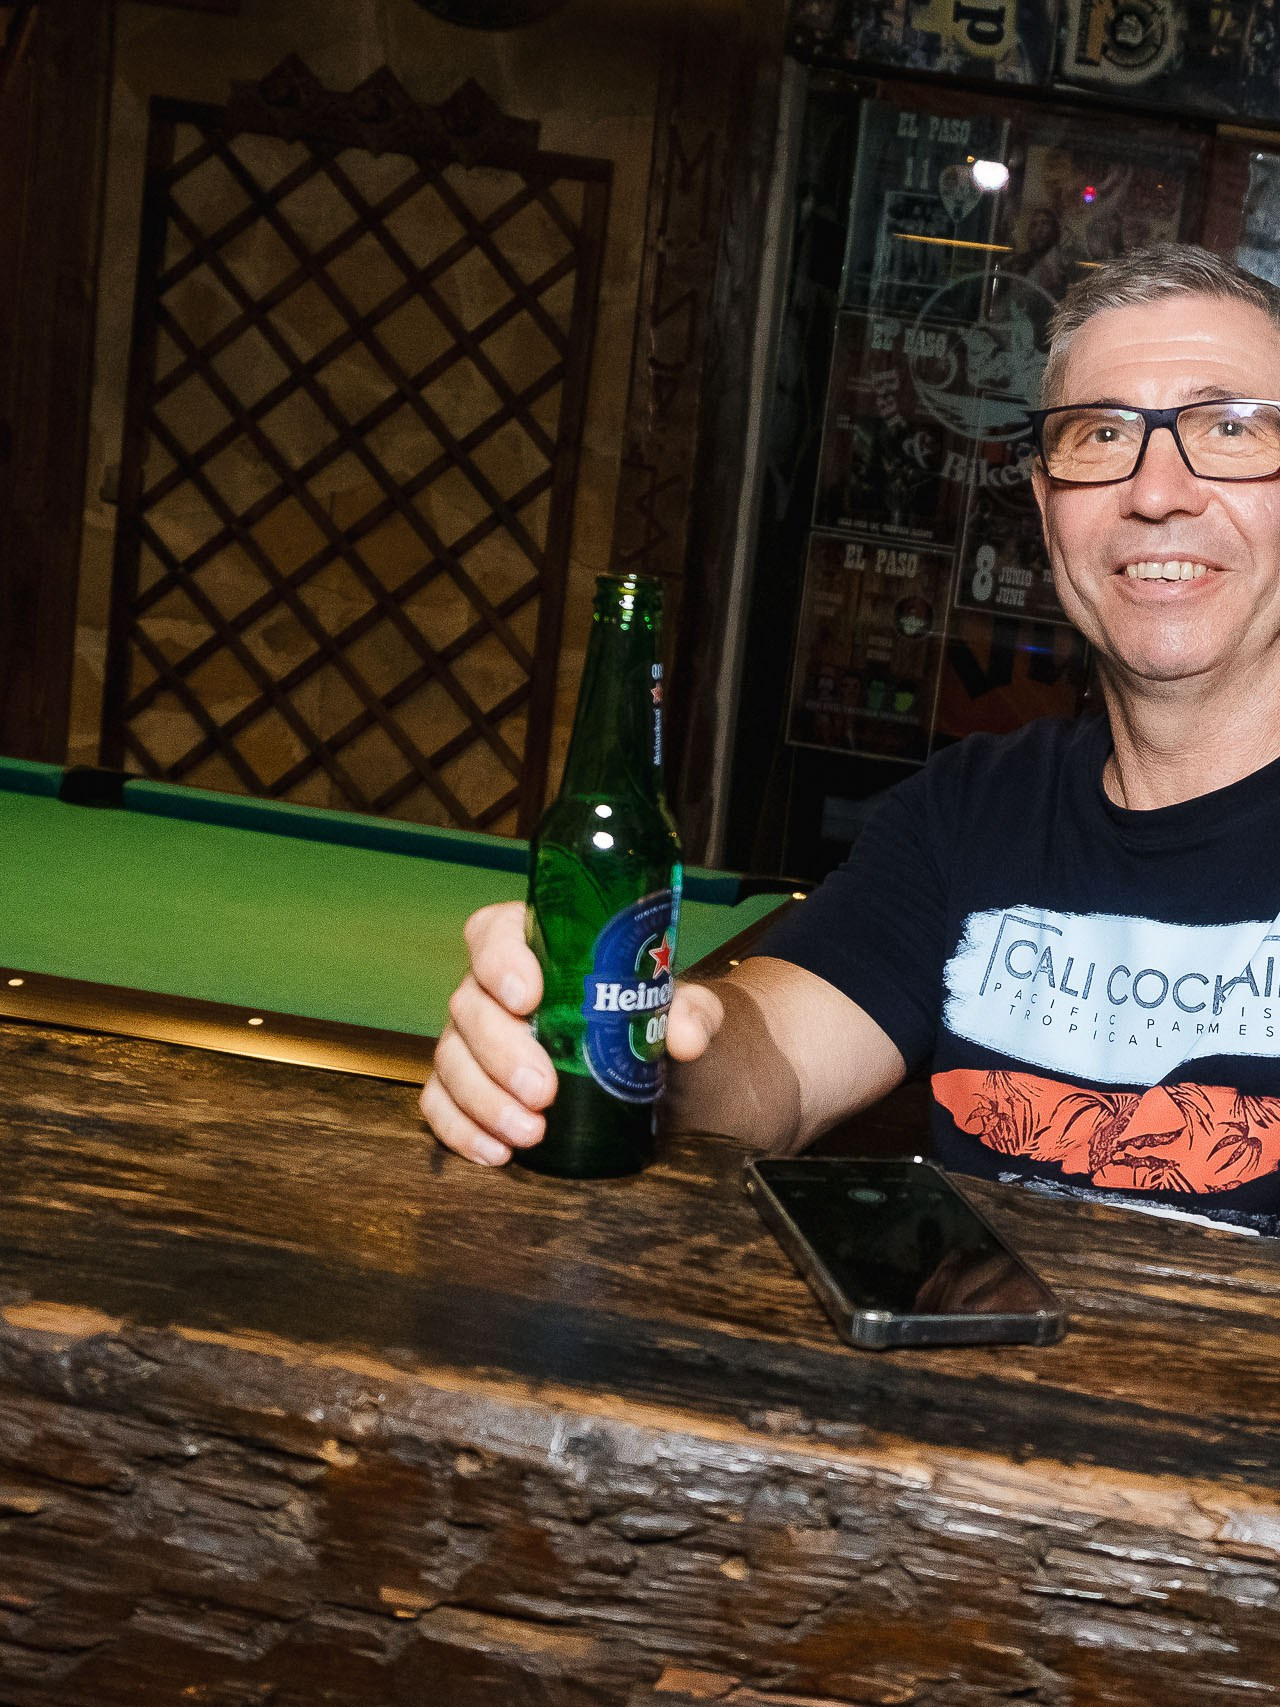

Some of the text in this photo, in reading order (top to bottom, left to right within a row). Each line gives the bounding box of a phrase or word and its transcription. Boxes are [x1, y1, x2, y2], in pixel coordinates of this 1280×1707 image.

[897, 111, 972, 146] EL PASO
[844, 543, 920, 578] EL PASO
[971, 543, 997, 603] 8
[1004, 938, 1097, 1001] CALI
[592, 974, 674, 1012] Heine
[993, 981, 1118, 1026] PACIFIC
[1008, 1004, 1164, 1049] TROPICAL
